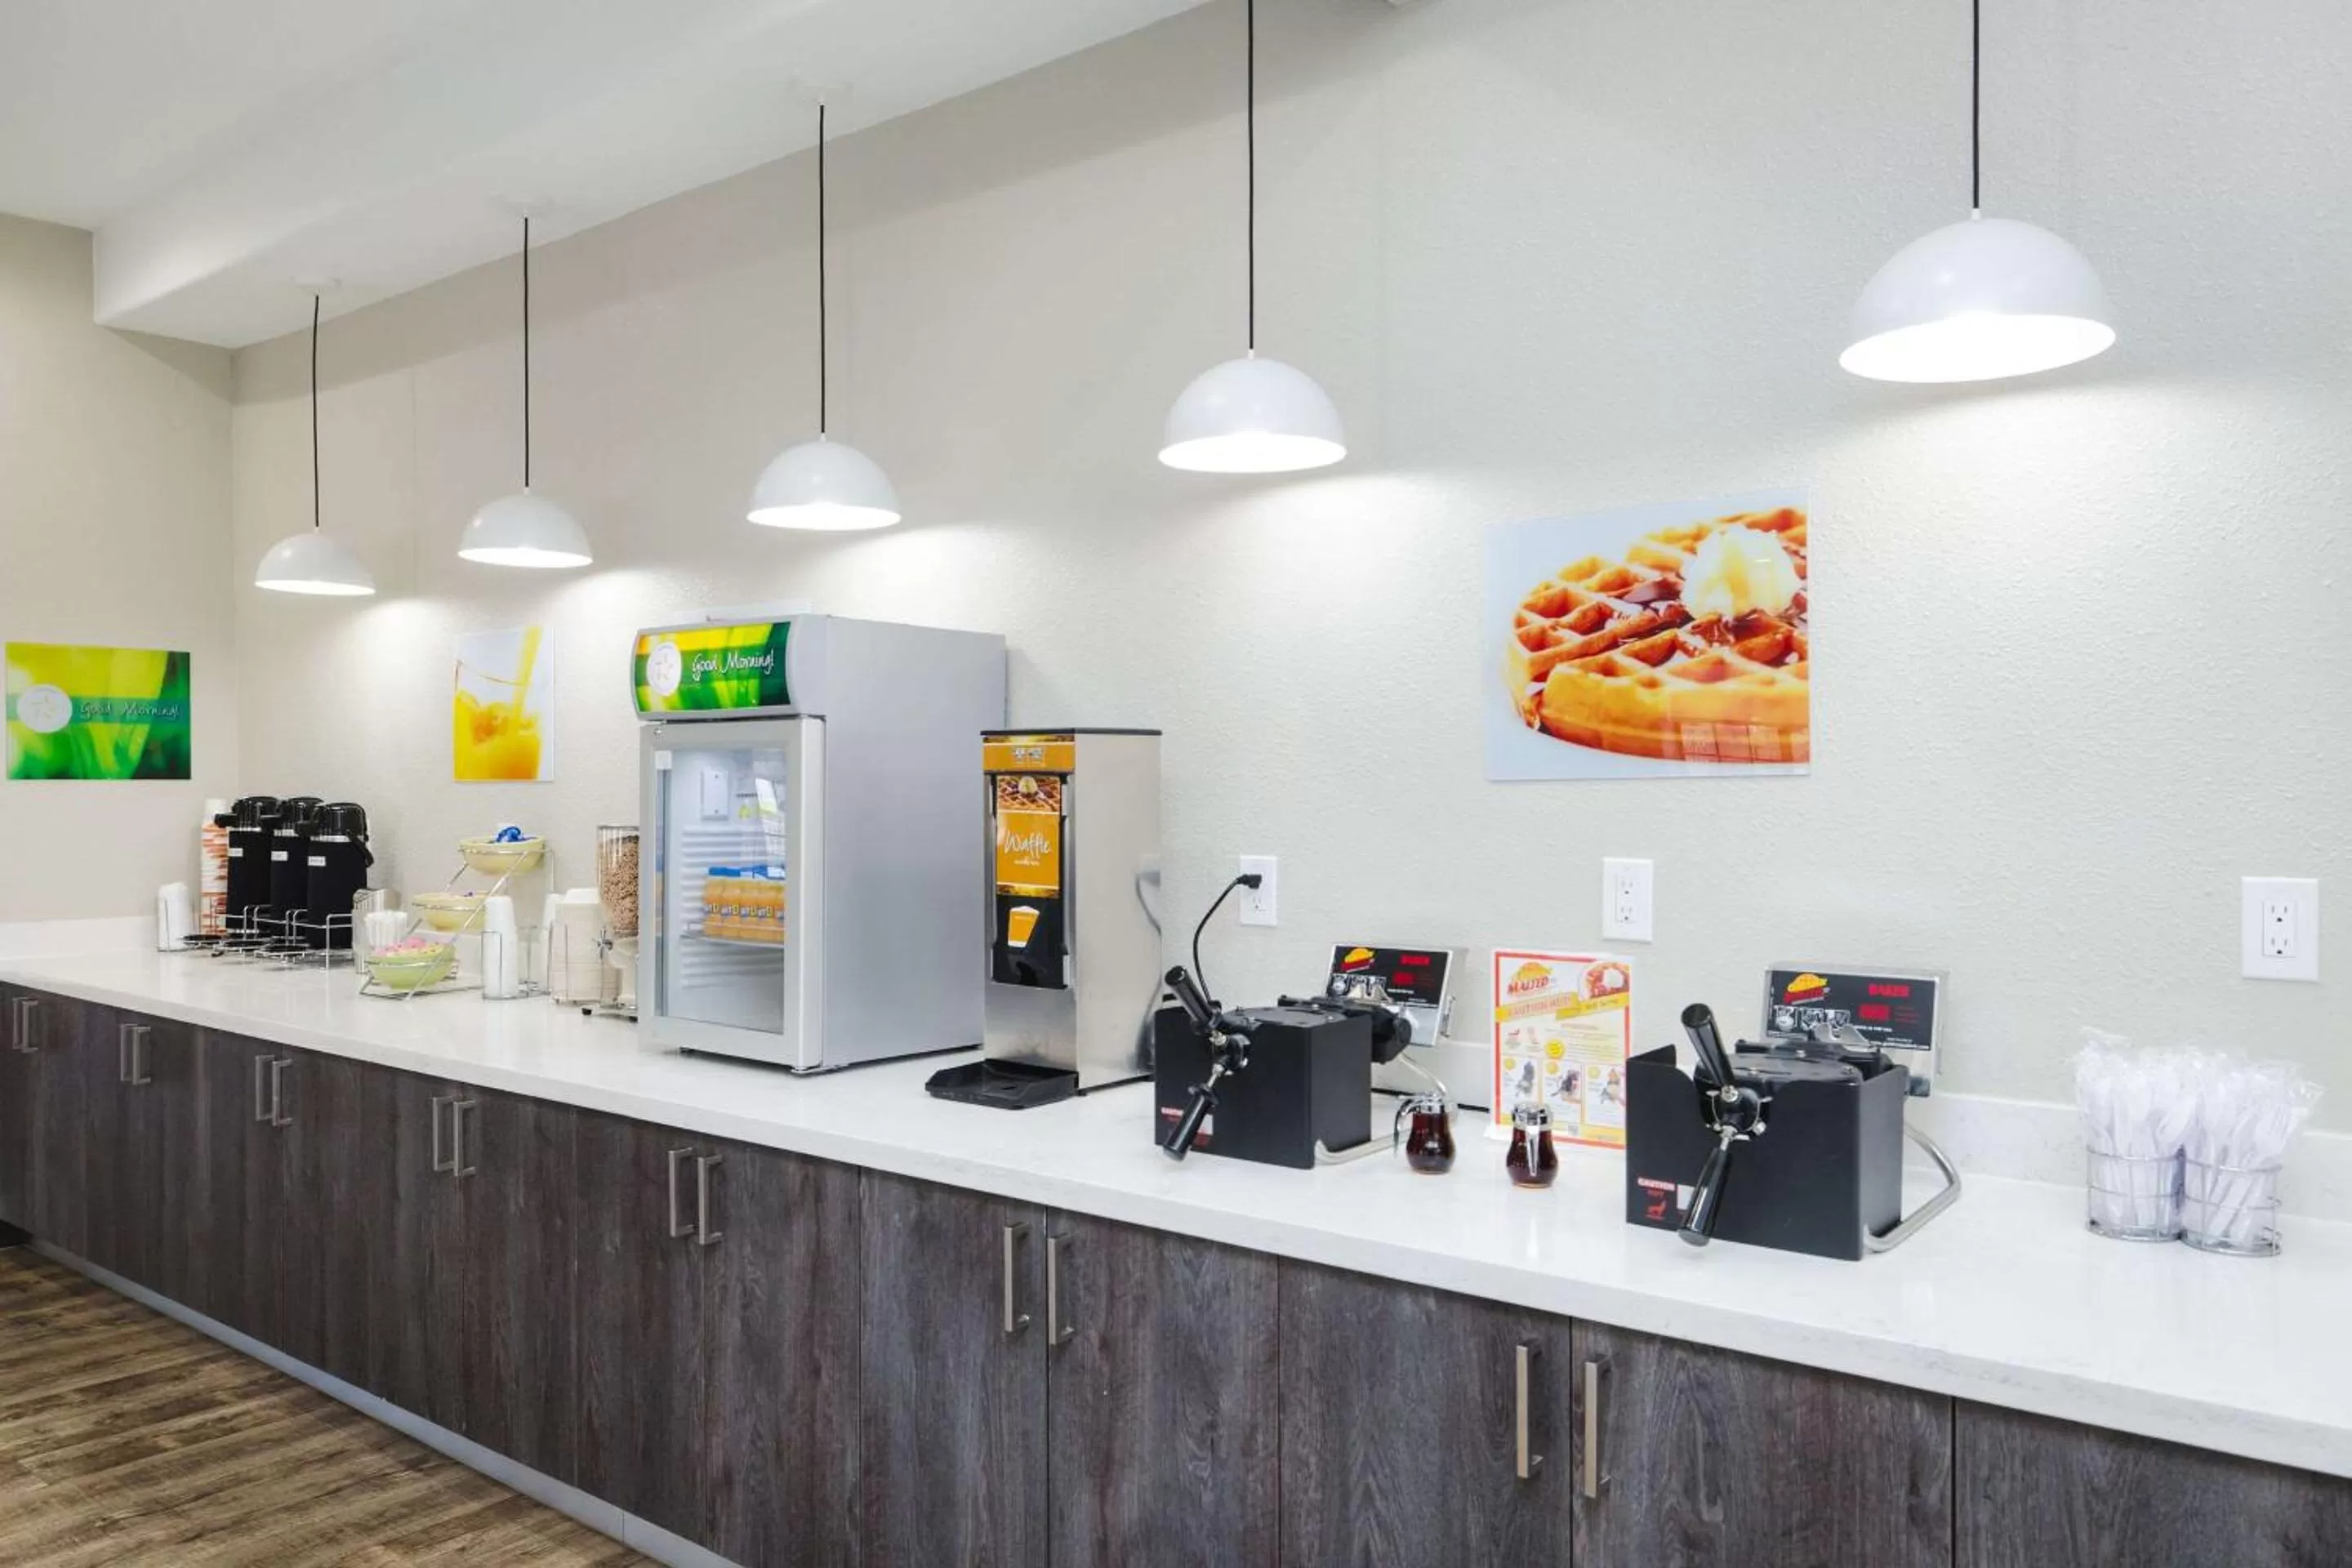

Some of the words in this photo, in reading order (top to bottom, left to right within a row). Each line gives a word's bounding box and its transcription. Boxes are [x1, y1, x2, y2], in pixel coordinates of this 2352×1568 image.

[693, 653, 718, 681] Good
[719, 648, 774, 675] Morning!
[1004, 830, 1051, 857] Waffle
